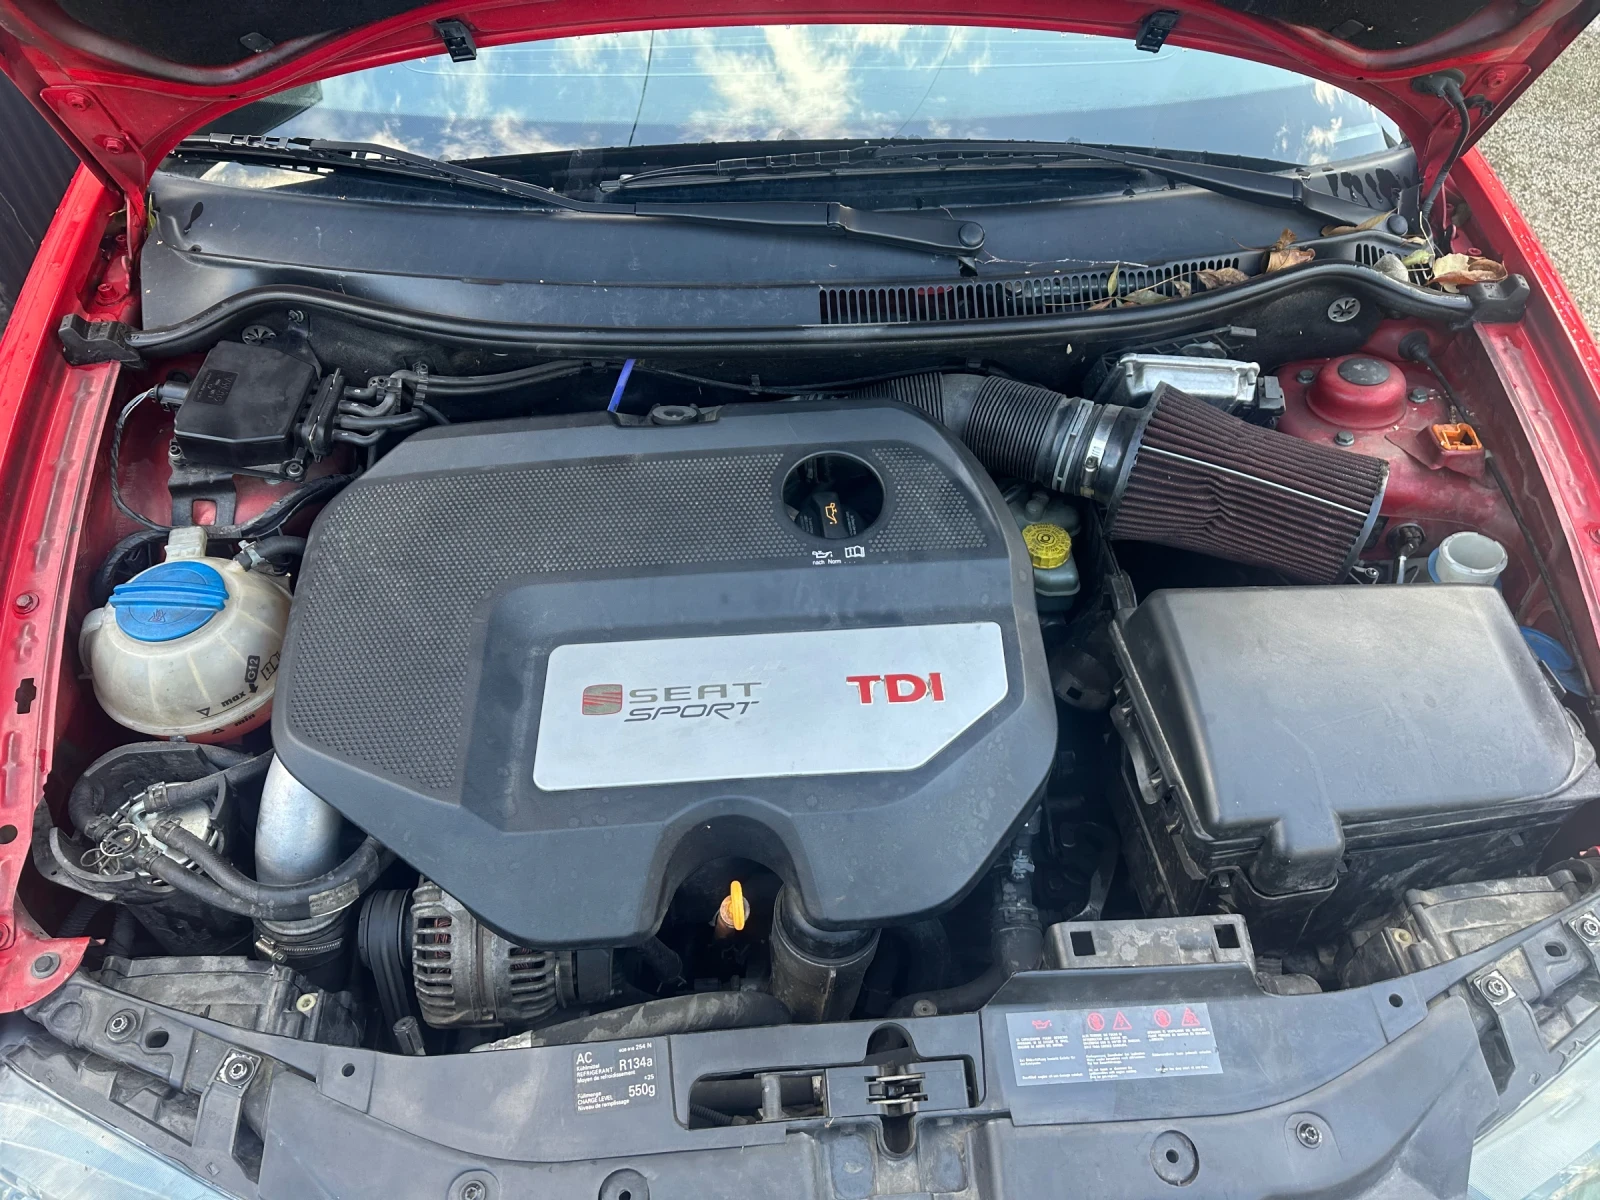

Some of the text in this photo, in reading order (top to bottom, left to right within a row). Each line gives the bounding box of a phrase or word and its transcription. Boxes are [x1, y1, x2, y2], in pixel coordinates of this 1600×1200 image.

[248, 658, 258, 680] G12
[628, 681, 762, 704] SEAT
[846, 672, 945, 705] TDI
[221, 691, 246, 707] max
[623, 700, 760, 723] SPORT
[234, 713, 256, 726] min
[576, 1051, 593, 1065] AC
[619, 1056, 653, 1071] R134a
[576, 1066, 614, 1077] REFRIGERANT
[628, 1083, 656, 1097] 550g
[577, 1094, 614, 1106] CHARGE LEVEL
[601, 1099, 630, 1108] remplissage
